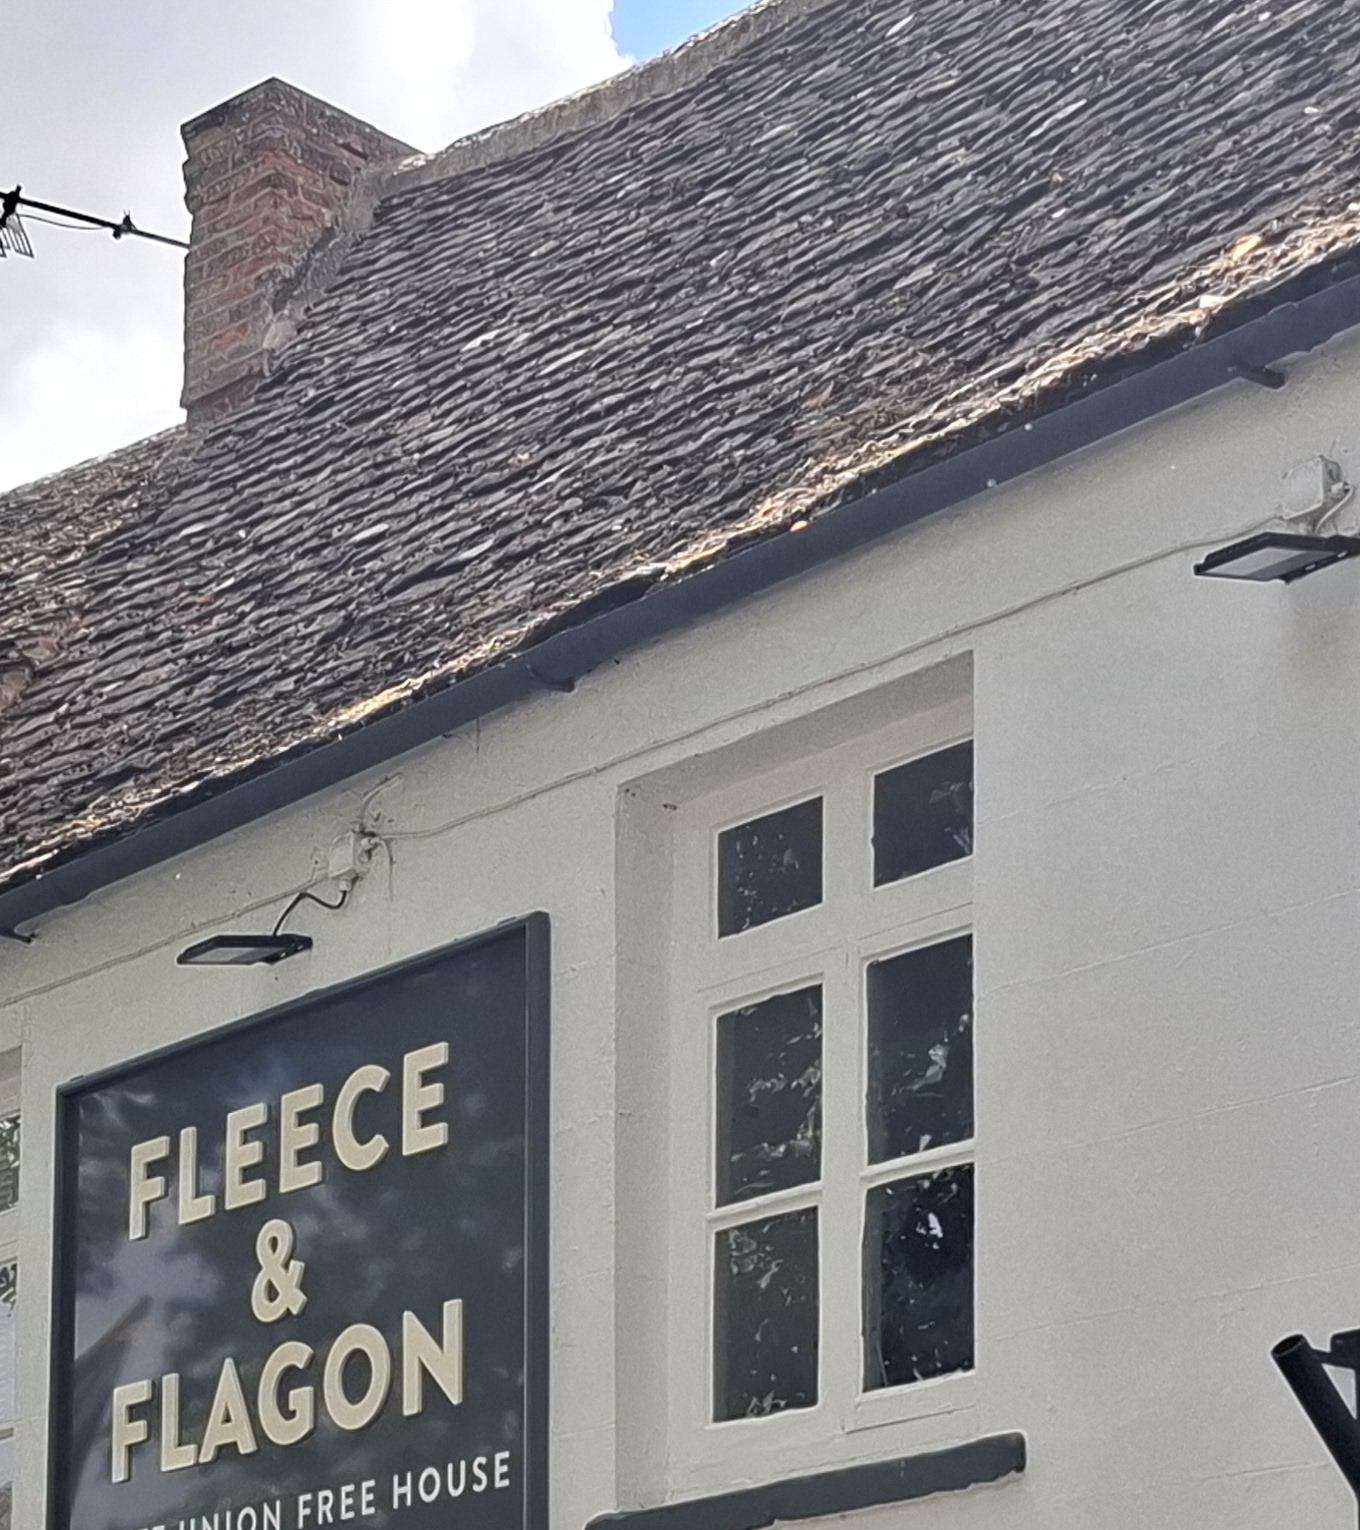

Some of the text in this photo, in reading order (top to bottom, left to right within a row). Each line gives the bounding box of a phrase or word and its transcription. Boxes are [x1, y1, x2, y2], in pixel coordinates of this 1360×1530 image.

[128, 1041, 451, 1241] FLEECE
[250, 1218, 308, 1323] &
[111, 1298, 464, 1483] FLAGON
[392, 1450, 512, 1511] HOUSE
